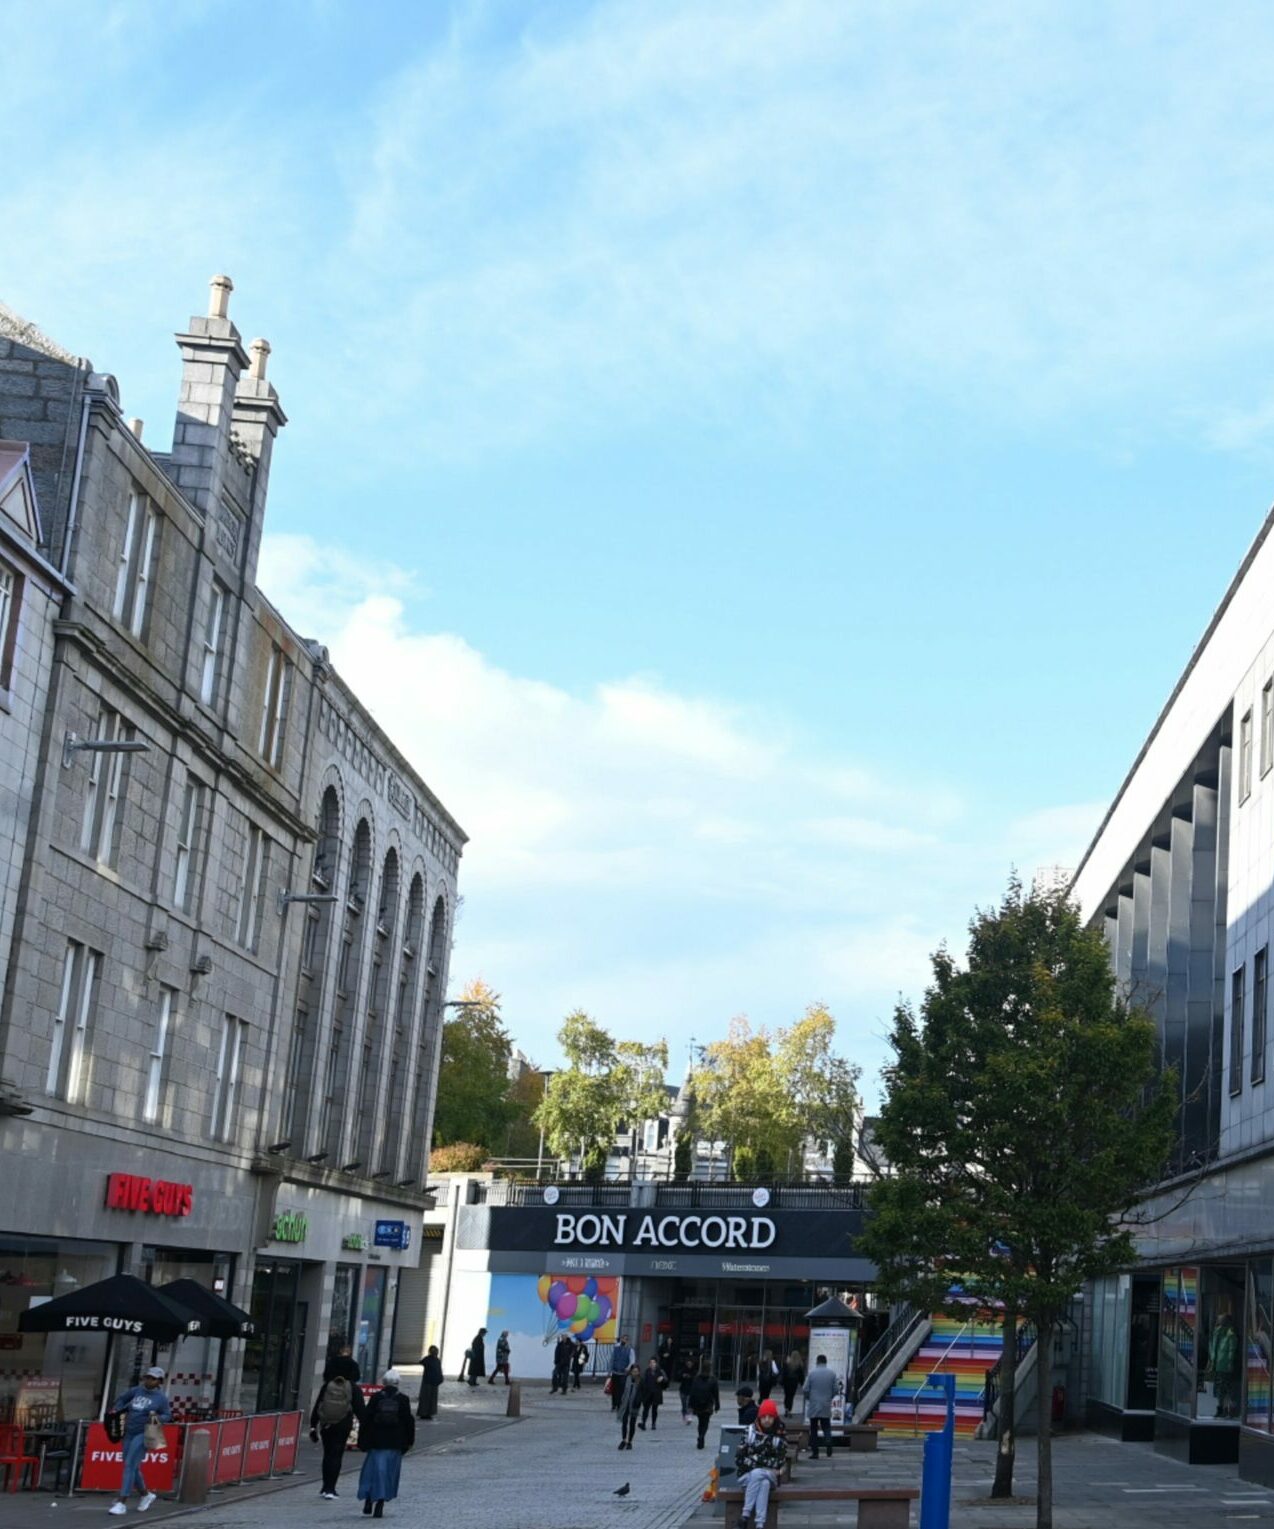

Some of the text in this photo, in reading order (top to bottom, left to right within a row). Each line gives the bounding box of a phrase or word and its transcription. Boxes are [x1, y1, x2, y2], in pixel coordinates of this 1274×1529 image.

[108, 1173, 151, 1212] FIVE
[153, 1179, 192, 1216] GUYS
[554, 1213, 776, 1249] BON ACCORD
[65, 1316, 143, 1333] FIVE GUYS
[91, 1451, 169, 1463] FIVE UYS
